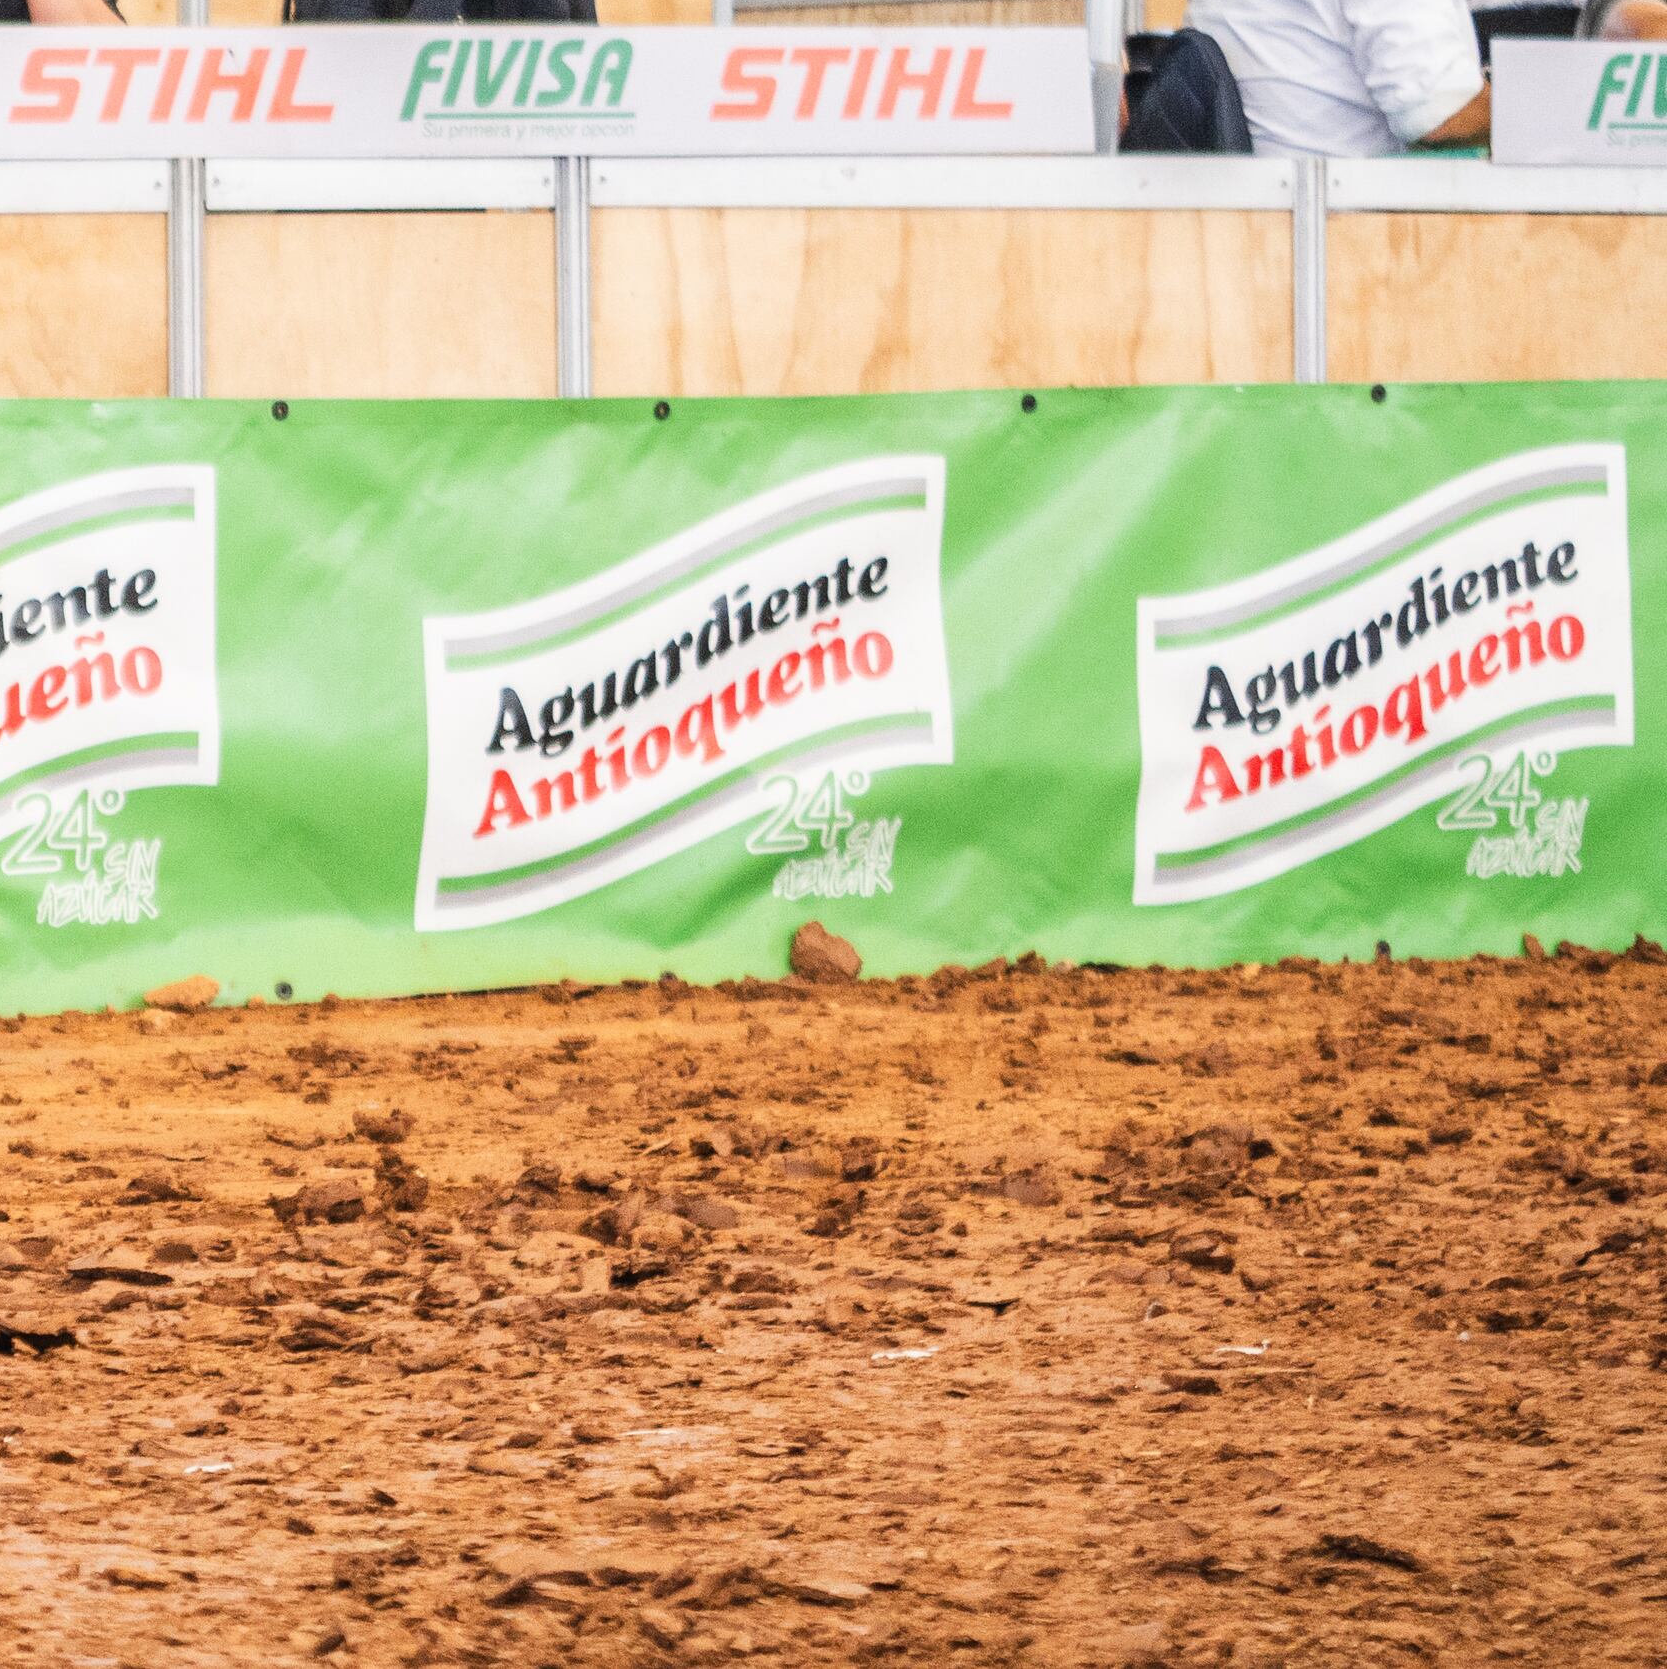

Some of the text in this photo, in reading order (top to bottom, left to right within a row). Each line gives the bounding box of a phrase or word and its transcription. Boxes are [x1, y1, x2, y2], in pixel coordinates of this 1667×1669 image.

[8, 47, 335, 123] STIHL
[400, 38, 633, 122] FIVISA
[709, 46, 1013, 120] STIHL
[448, 124, 511, 140] primera
[485, 555, 889, 757] Aguardiente
[1192, 540, 1579, 737] Aguardiente
[472, 617, 894, 841] Antioqueño
[1184, 600, 1585, 814] Antioqueño
[103, 839, 161, 884] SIN
